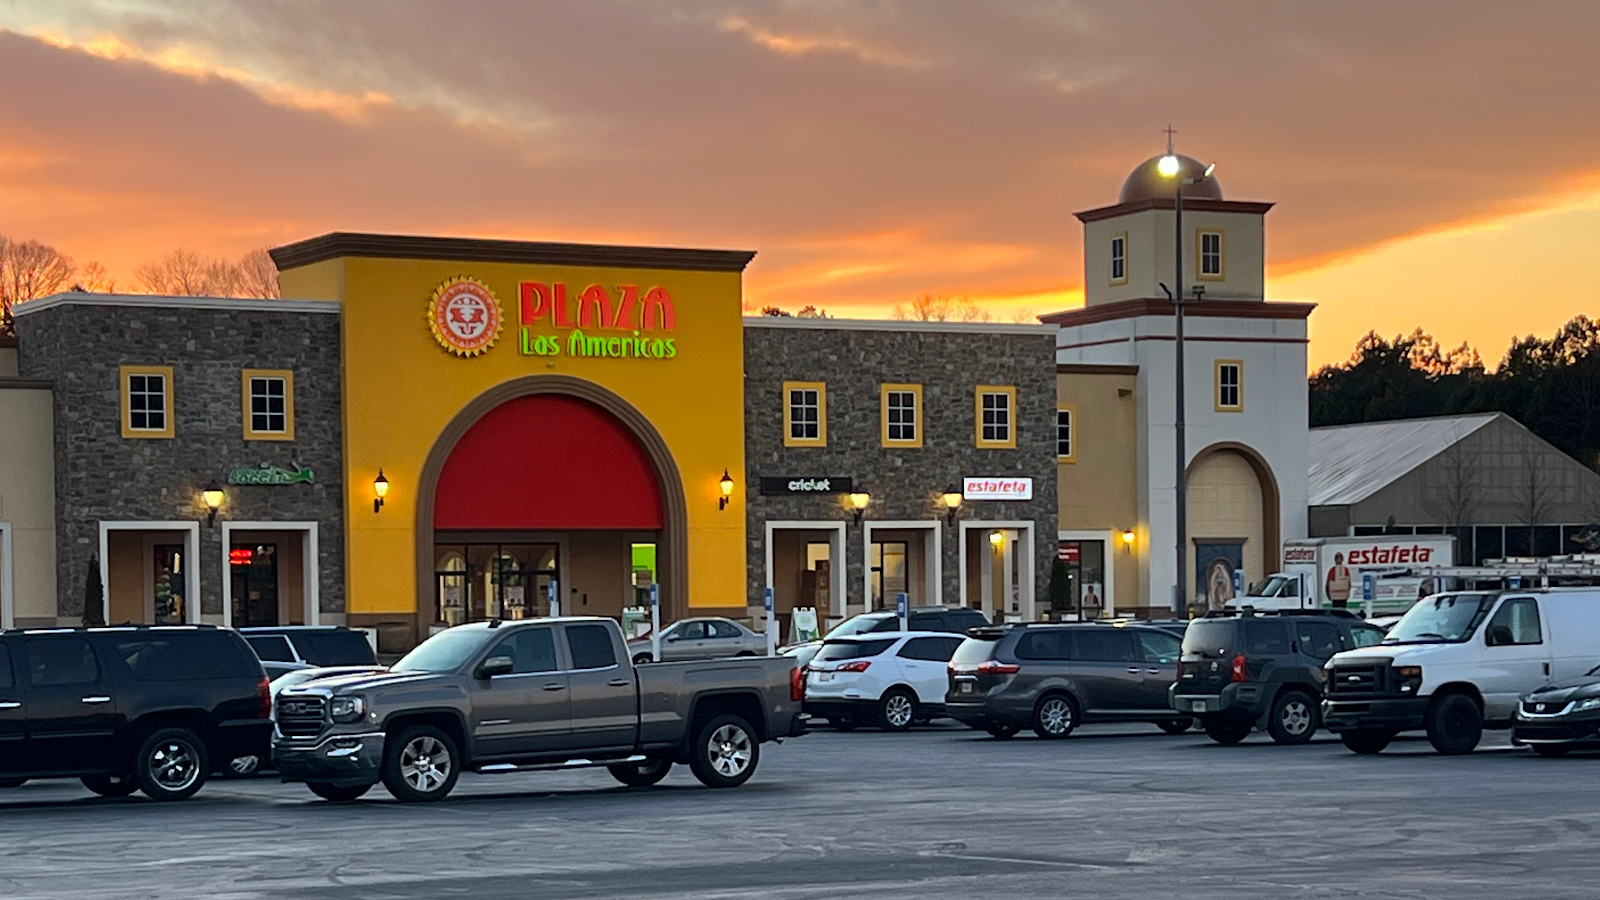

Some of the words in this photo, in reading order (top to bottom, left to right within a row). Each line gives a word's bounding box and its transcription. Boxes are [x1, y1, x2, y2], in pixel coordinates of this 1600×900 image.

[518, 281, 677, 332] PLAZA
[520, 327, 561, 357] Las
[568, 329, 677, 359] Americas
[787, 478, 831, 492] cricket
[966, 480, 1027, 492] estafeta
[1348, 544, 1431, 565] estafeta
